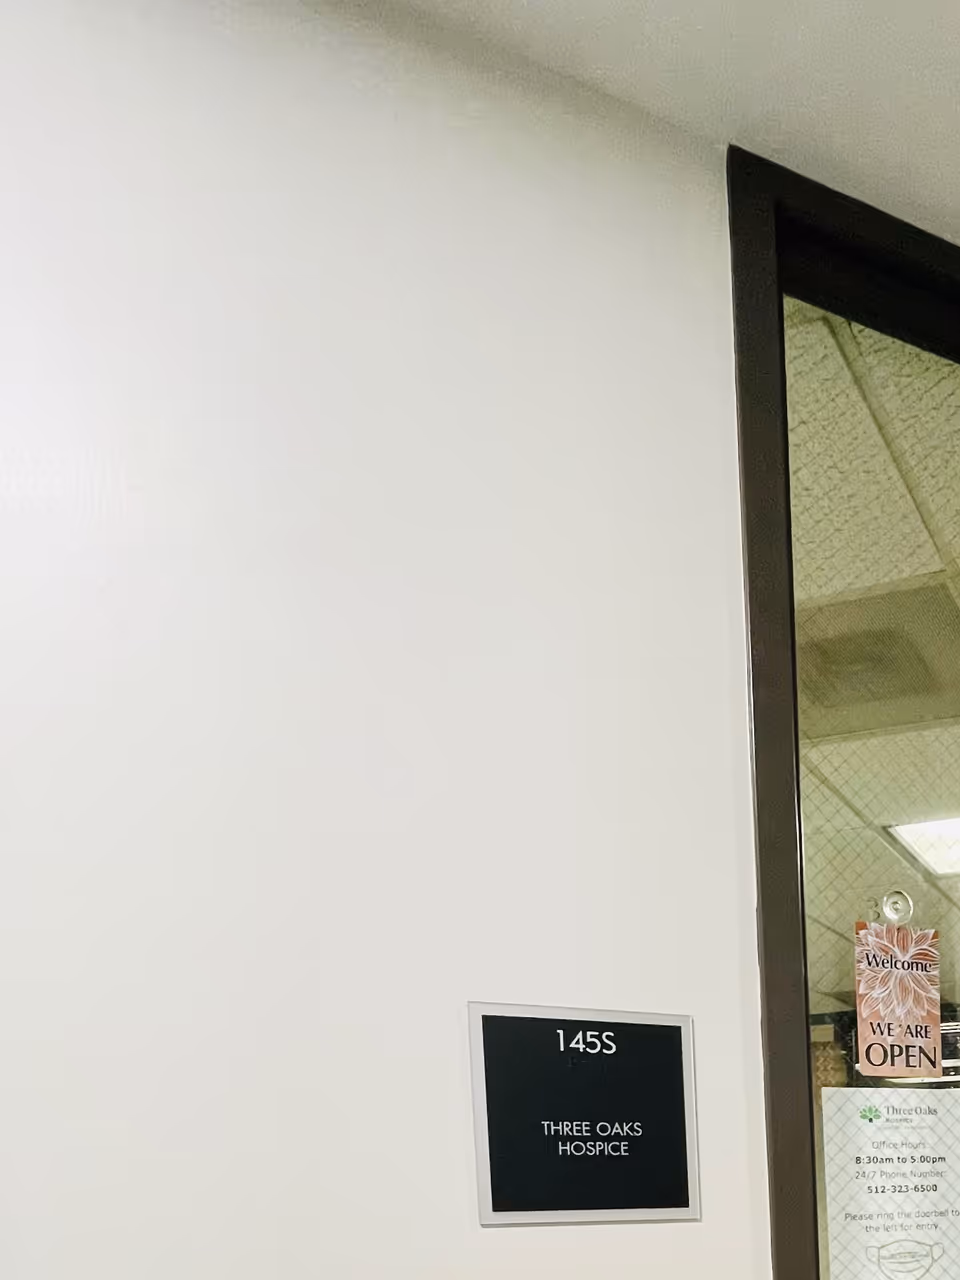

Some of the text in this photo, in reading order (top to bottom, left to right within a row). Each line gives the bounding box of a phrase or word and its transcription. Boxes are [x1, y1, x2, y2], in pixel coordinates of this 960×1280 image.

[865, 952, 932, 973] Welcome
[869, 1021, 932, 1040] WE ARE
[556, 1029, 617, 1054] 145S
[865, 1042, 937, 1069] OPEN
[884, 1105, 938, 1116] Three Oaks
[541, 1121, 643, 1137] THREE OAKS
[558, 1141, 630, 1156] HOSPICE
[872, 1141, 898, 1150] Office
[855, 1155, 946, 1165] 8:30am to 5:00pm
[855, 1171, 876, 1180] 24/7
[880, 1170, 907, 1179] Phone
[867, 1184, 938, 1194] 512-323-6500
[844, 1209, 960, 1221] Please ring the doorbell to
[865, 1225, 880, 1233] the
[883, 1224, 898, 1232] left
[899, 1222, 912, 1231] for
